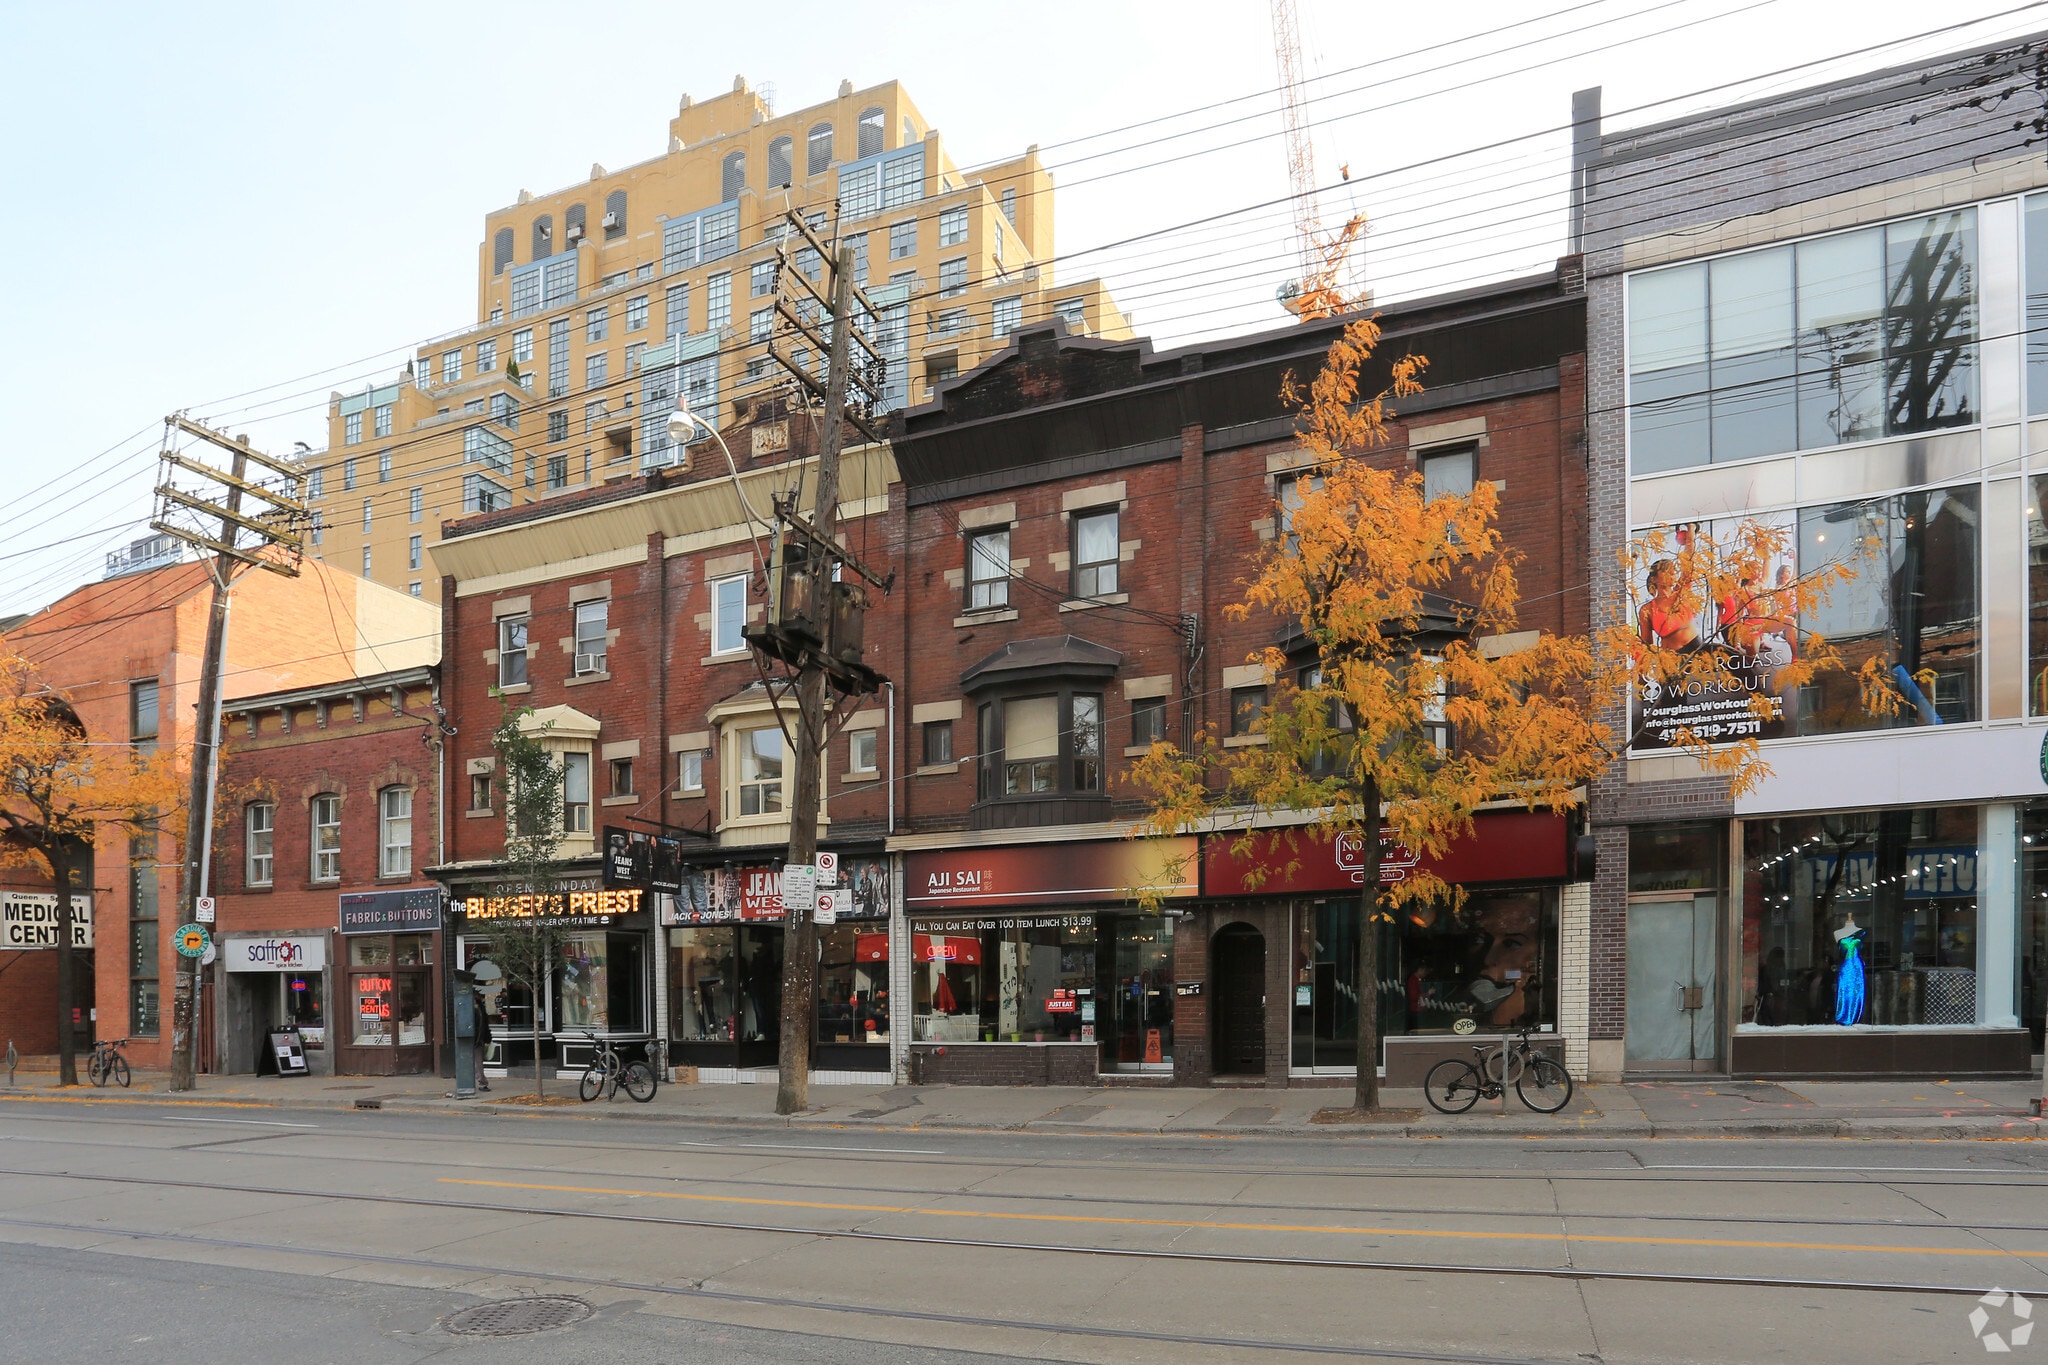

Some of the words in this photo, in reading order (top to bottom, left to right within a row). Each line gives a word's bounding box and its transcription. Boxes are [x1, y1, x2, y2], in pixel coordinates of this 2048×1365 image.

[1682, 650, 1783, 675] ORGLASS
[1668, 673, 1770, 698] WORKOUT
[614, 855, 633, 867] JEANS
[616, 866, 631, 875] WEST
[745, 872, 783, 897] JEAN
[928, 872, 950, 887] AJI
[956, 870, 981, 886] SAI
[49, 895, 82, 903] Spna
[450, 899, 467, 913] the
[466, 893, 564, 919] BURGER'S
[569, 889, 643, 915] PRIEST
[745, 896, 783, 908] WES
[345, 911, 381, 924] FABRIC
[387, 908, 433, 922] BUTTONS
[583, 916, 598, 925] TIME
[669, 911, 692, 921] JACK
[700, 910, 730, 920] JONES
[1062, 916, 1092, 927] $13.99
[10, 924, 87, 945] CENTR
[248, 939, 303, 963] saffron
[926, 945, 957, 957] OPEN
[360, 1004, 379, 1014] RENT
[1455, 1020, 1476, 1032] OPEN
